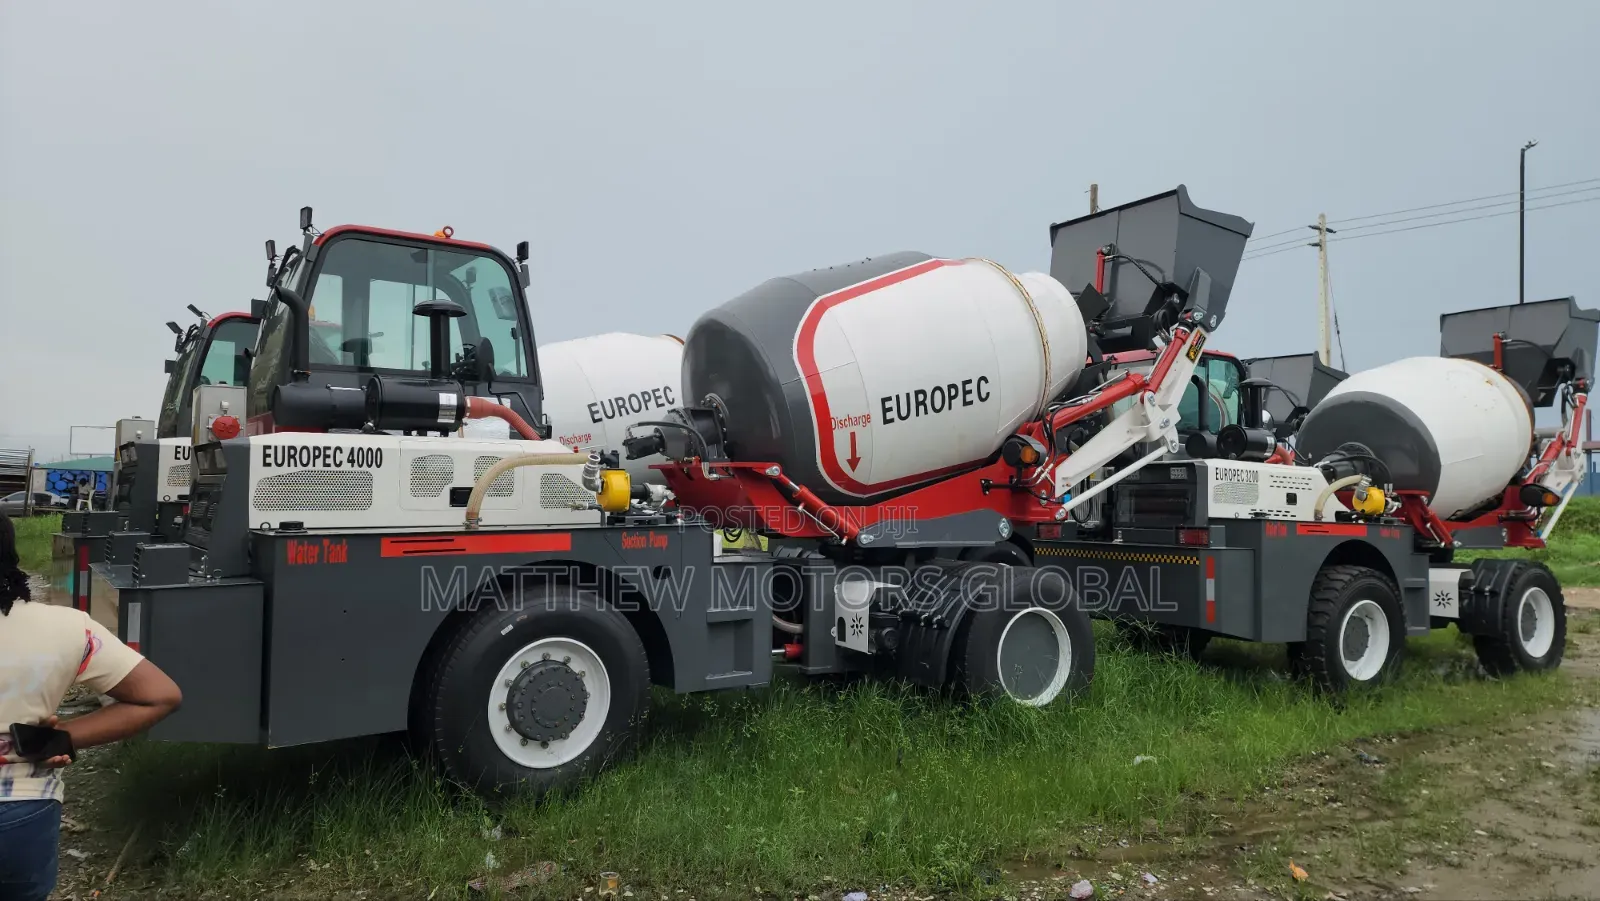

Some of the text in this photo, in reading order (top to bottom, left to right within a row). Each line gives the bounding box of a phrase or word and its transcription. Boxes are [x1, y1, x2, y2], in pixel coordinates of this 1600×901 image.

[587, 385, 676, 424] EUROPEC
[881, 375, 991, 426] EUROPEC
[830, 411, 872, 431] Discharge
[559, 432, 592, 445] Discharge
[262, 445, 383, 468] EUROPEC 4000
[1215, 467, 1245, 482] EUROPEC
[621, 531, 668, 550] Suction Pump
[286, 539, 348, 565] Water Tank
